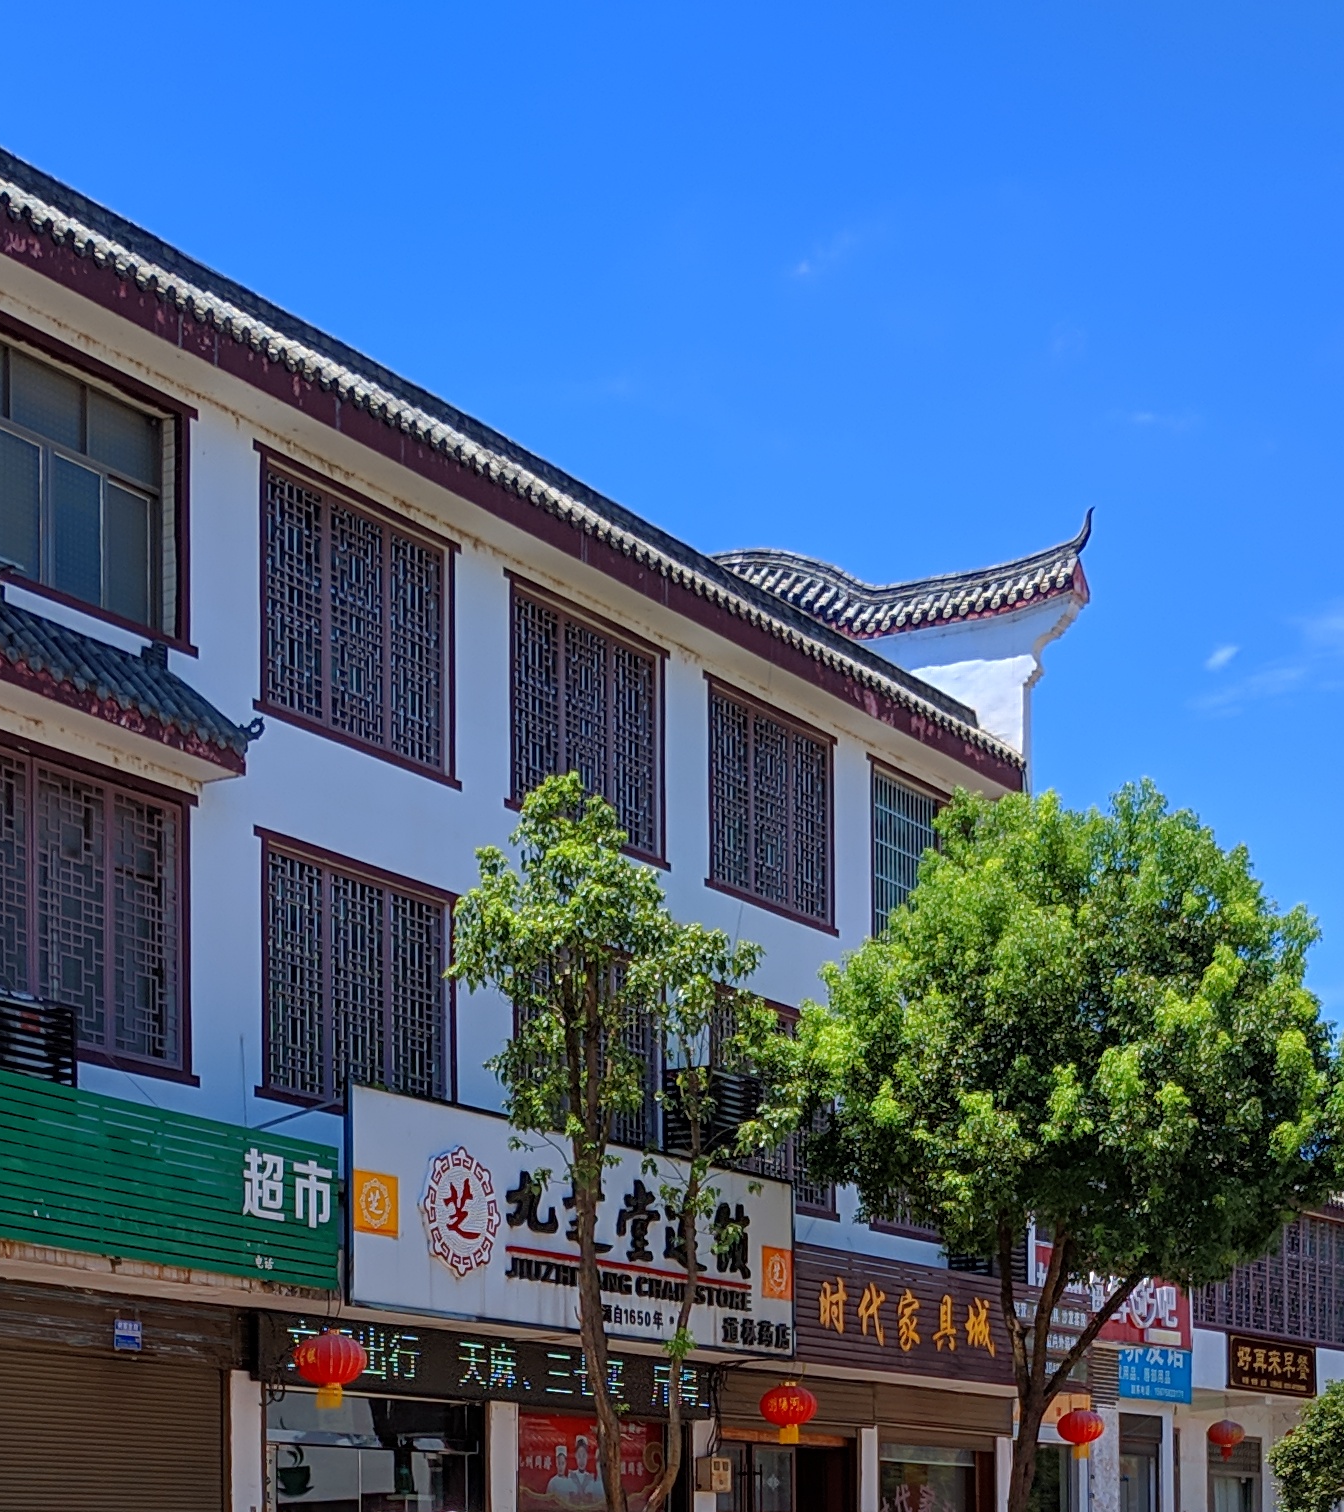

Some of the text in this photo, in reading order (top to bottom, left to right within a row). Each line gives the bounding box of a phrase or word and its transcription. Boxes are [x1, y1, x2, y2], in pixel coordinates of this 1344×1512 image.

[242, 1147, 333, 1229] 超市
[443, 1178, 481, 1240] 芝
[692, 1285, 753, 1312] STORE
[818, 1276, 997, 1358] 时代家具城
[1236, 1345, 1311, 1381] 好再来早餐
